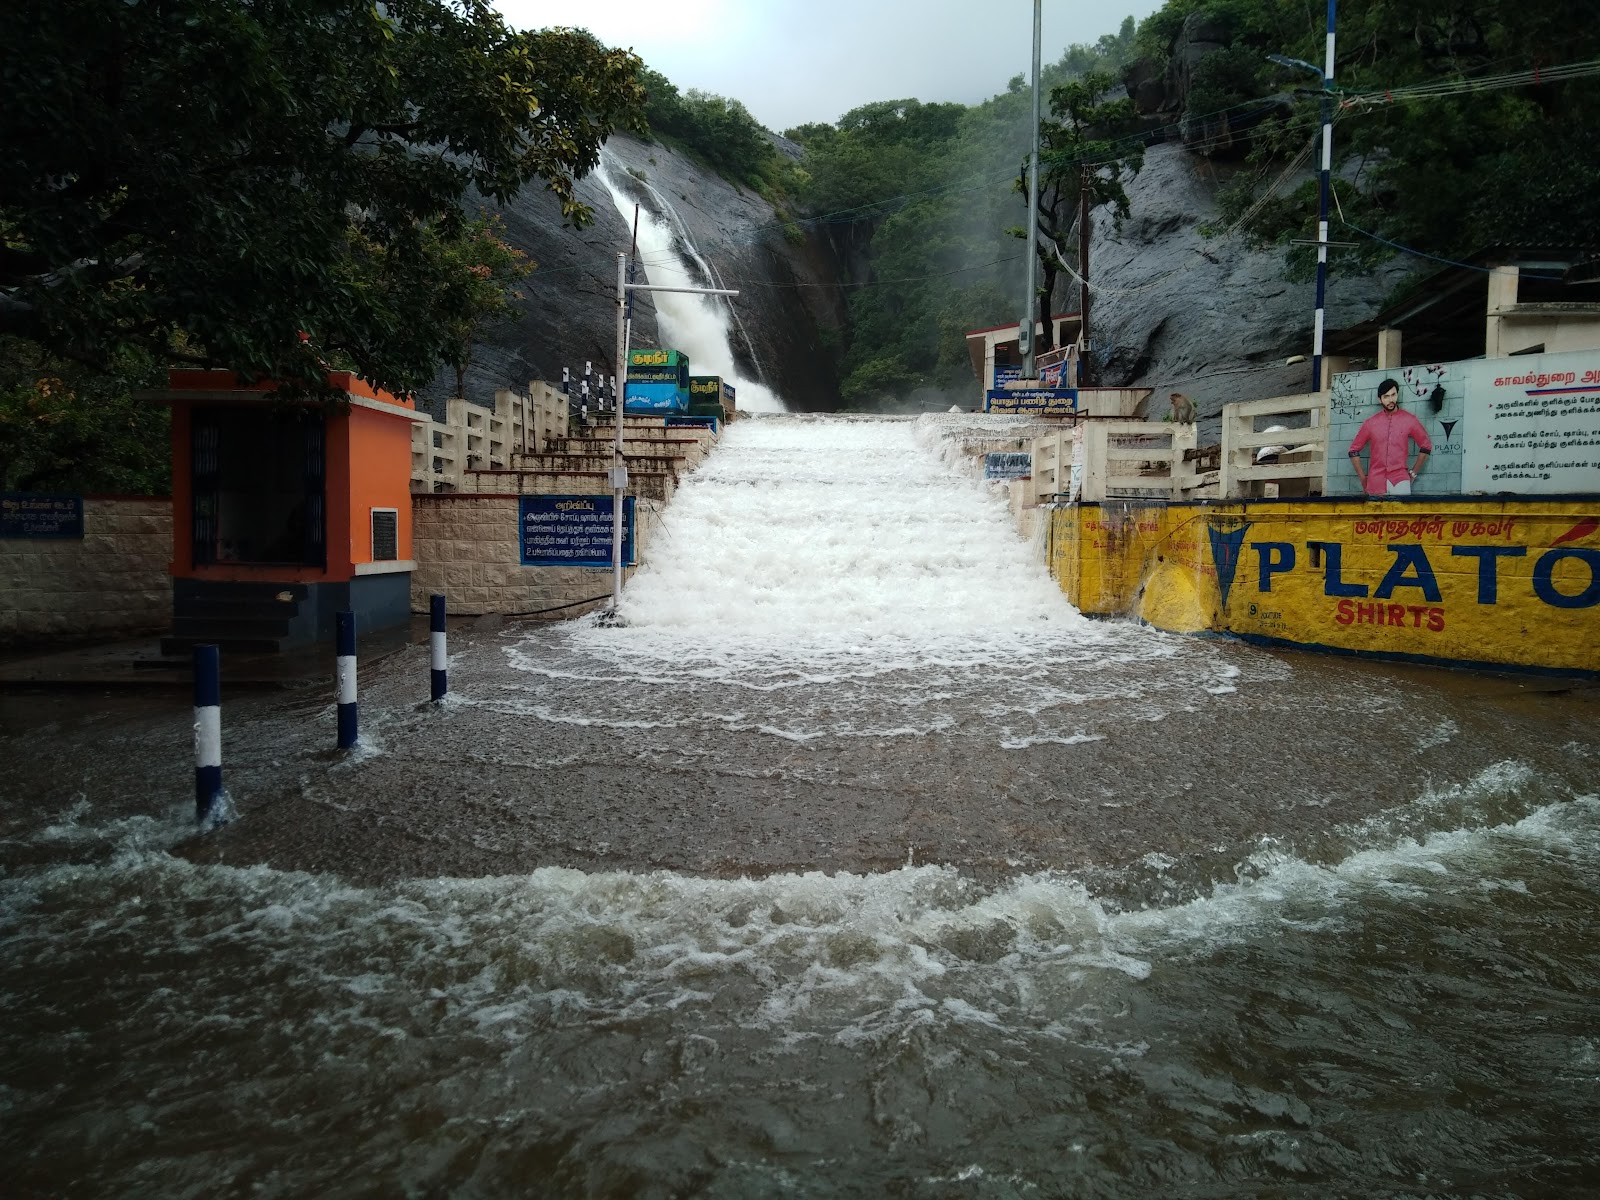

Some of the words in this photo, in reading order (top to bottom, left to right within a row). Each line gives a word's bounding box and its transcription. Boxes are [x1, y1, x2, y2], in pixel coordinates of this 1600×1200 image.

[632, 351, 669, 365] குடிநீர்
[1494, 371, 1576, 388] காவல்துறை
[690, 380, 719, 394] குடிநீர்
[1496, 399, 1539, 410] அருவிகளில்
[1541, 396, 1578, 408] குளிக்கும்
[1493, 430, 1537, 441] அருவிகளில்
[1493, 440, 1525, 449] சீயக்காய்
[1527, 440, 1557, 449] தேய்த்து
[1492, 461, 1536, 471] அருவிகளில்
[1538, 460, 1588, 470] குளிப்பவர்கள்
[555, 500, 594, 512] அறிவிப்பு
[1336, 599, 1446, 632] SHIRTS
